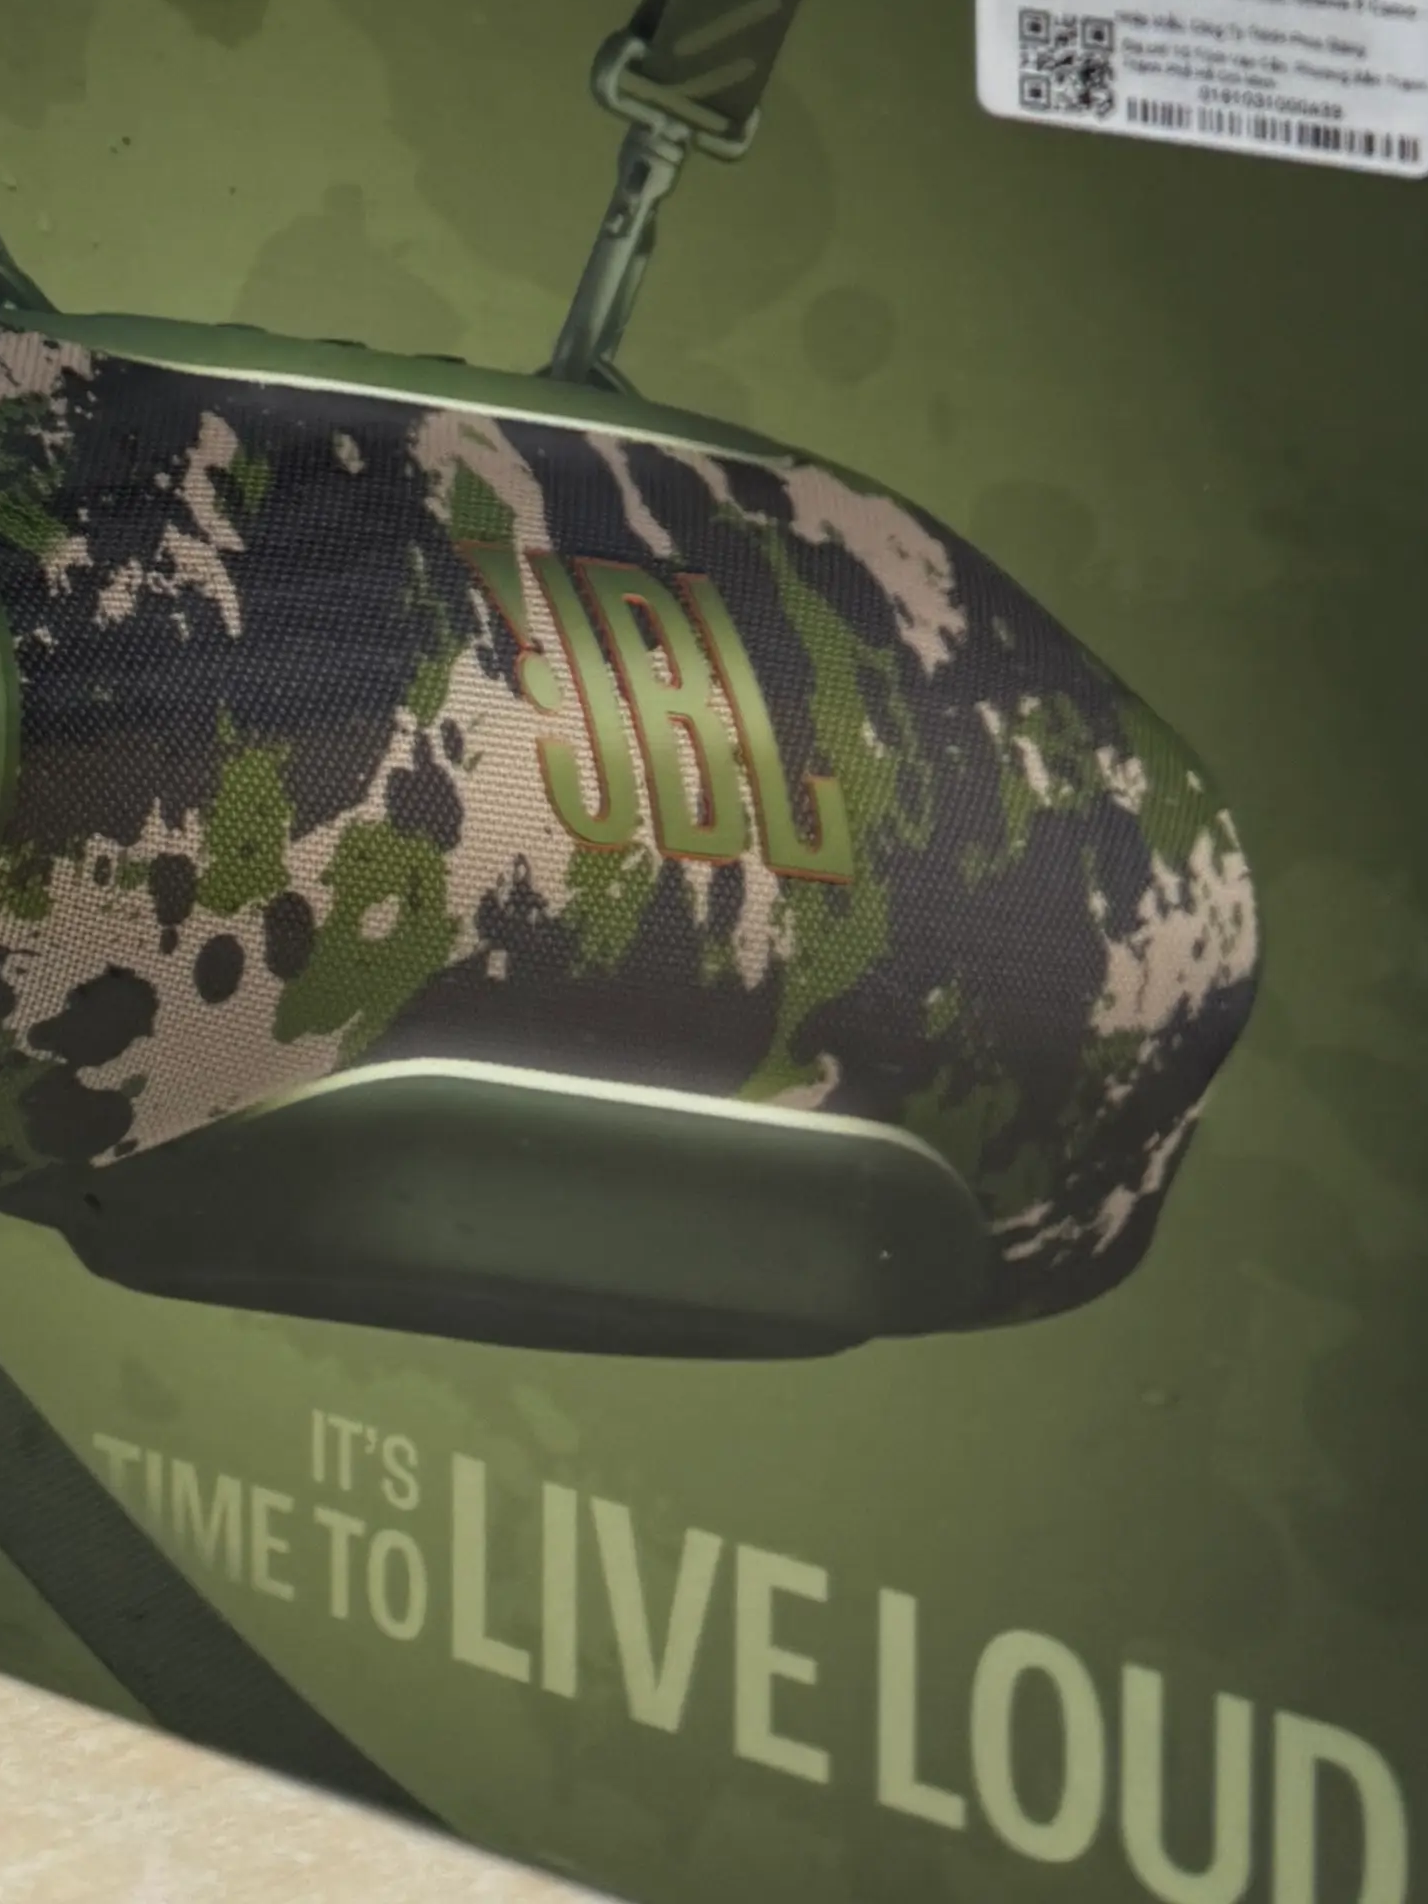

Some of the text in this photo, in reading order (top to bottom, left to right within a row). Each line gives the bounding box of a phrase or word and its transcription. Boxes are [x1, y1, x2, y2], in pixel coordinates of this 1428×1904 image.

[459, 539, 854, 886] JBL
[93, 1431, 429, 1643] TIME TO
[310, 1409, 420, 1513] IT'S
[451, 1451, 1411, 1904] LIVE LOUD
